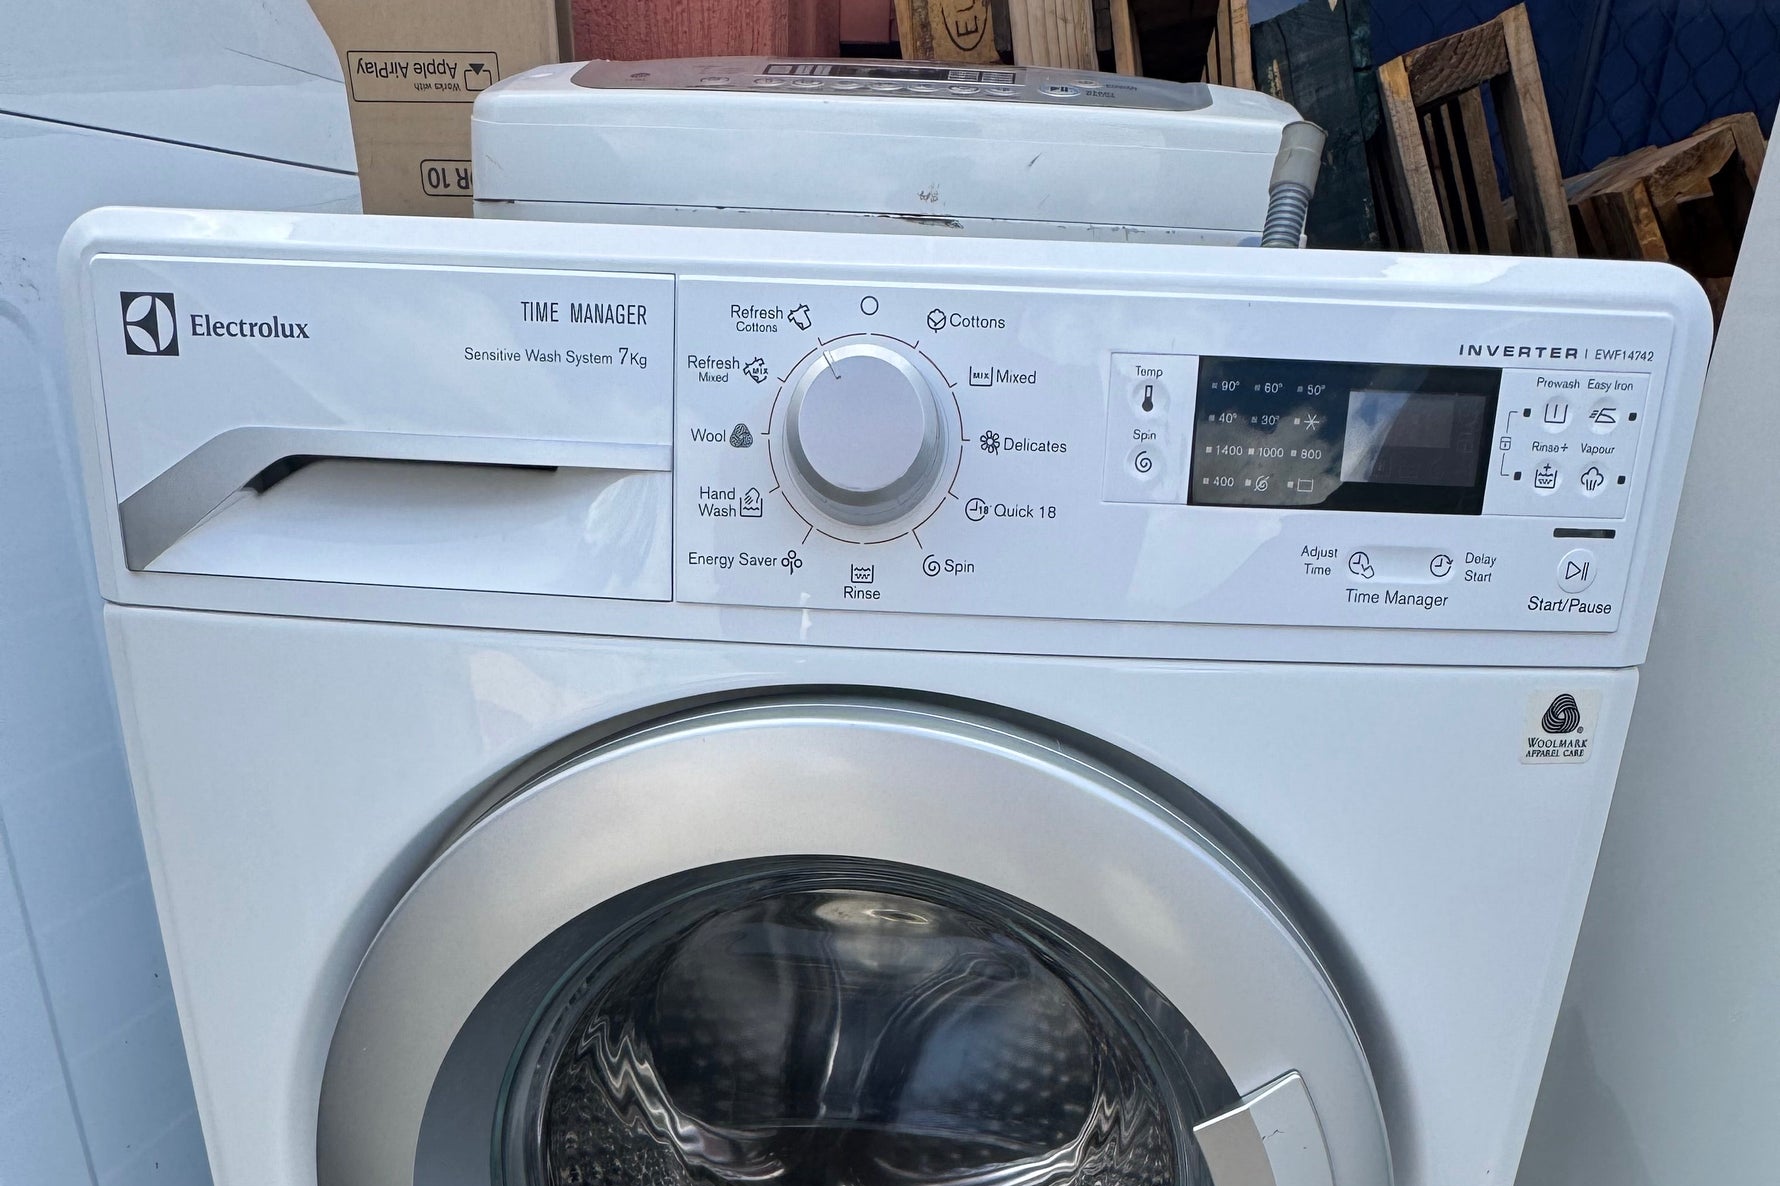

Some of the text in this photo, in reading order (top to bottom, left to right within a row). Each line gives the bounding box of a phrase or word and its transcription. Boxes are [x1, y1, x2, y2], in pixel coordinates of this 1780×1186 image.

[356, 57, 457, 79] Apple AirPlay
[414, 82, 461, 92] Works with
[427, 167, 473, 190] R 10
[521, 301, 647, 325] TIME MANAGER
[731, 304, 783, 320] Refresh
[190, 314, 310, 339] Electrolux
[736, 321, 778, 333] Cottons
[950, 312, 1006, 329] Cottons
[464, 347, 521, 361] Sensitive
[525, 349, 561, 363] Wash
[566, 350, 613, 367] System
[1456, 344, 1655, 362] INVERTER EWF14742
[687, 355, 740, 370] Refresh
[698, 371, 729, 383] Mixed
[996, 369, 1037, 384] Mixed
[1135, 365, 1164, 380] Temp
[1587, 378, 1634, 393] Easy Iron
[690, 428, 726, 443] Wool
[1132, 429, 1157, 443] Spin
[1004, 437, 1067, 453] Delicates
[1215, 445, 1244, 457] 1400
[1258, 447, 1285, 458] 1000
[1581, 443, 1616, 456] Vapour
[1212, 476, 1235, 488] 400
[699, 486, 736, 500] Hand
[698, 503, 737, 518] Wash
[994, 503, 1057, 519] Quick 18
[688, 551, 778, 569] Energy Saver
[1301, 545, 1338, 560] Adjust
[1465, 551, 1497, 568] Delay
[944, 558, 975, 576] Spin
[1304, 563, 1332, 576] Time
[1464, 570, 1492, 583] Start
[843, 585, 881, 600] Rinse
[1346, 588, 1449, 610] Time Manager
[1527, 595, 1612, 615] Start/Pause
[1527, 737, 1588, 749] WOOLMARK
[1562, 749, 1585, 758] CARE
